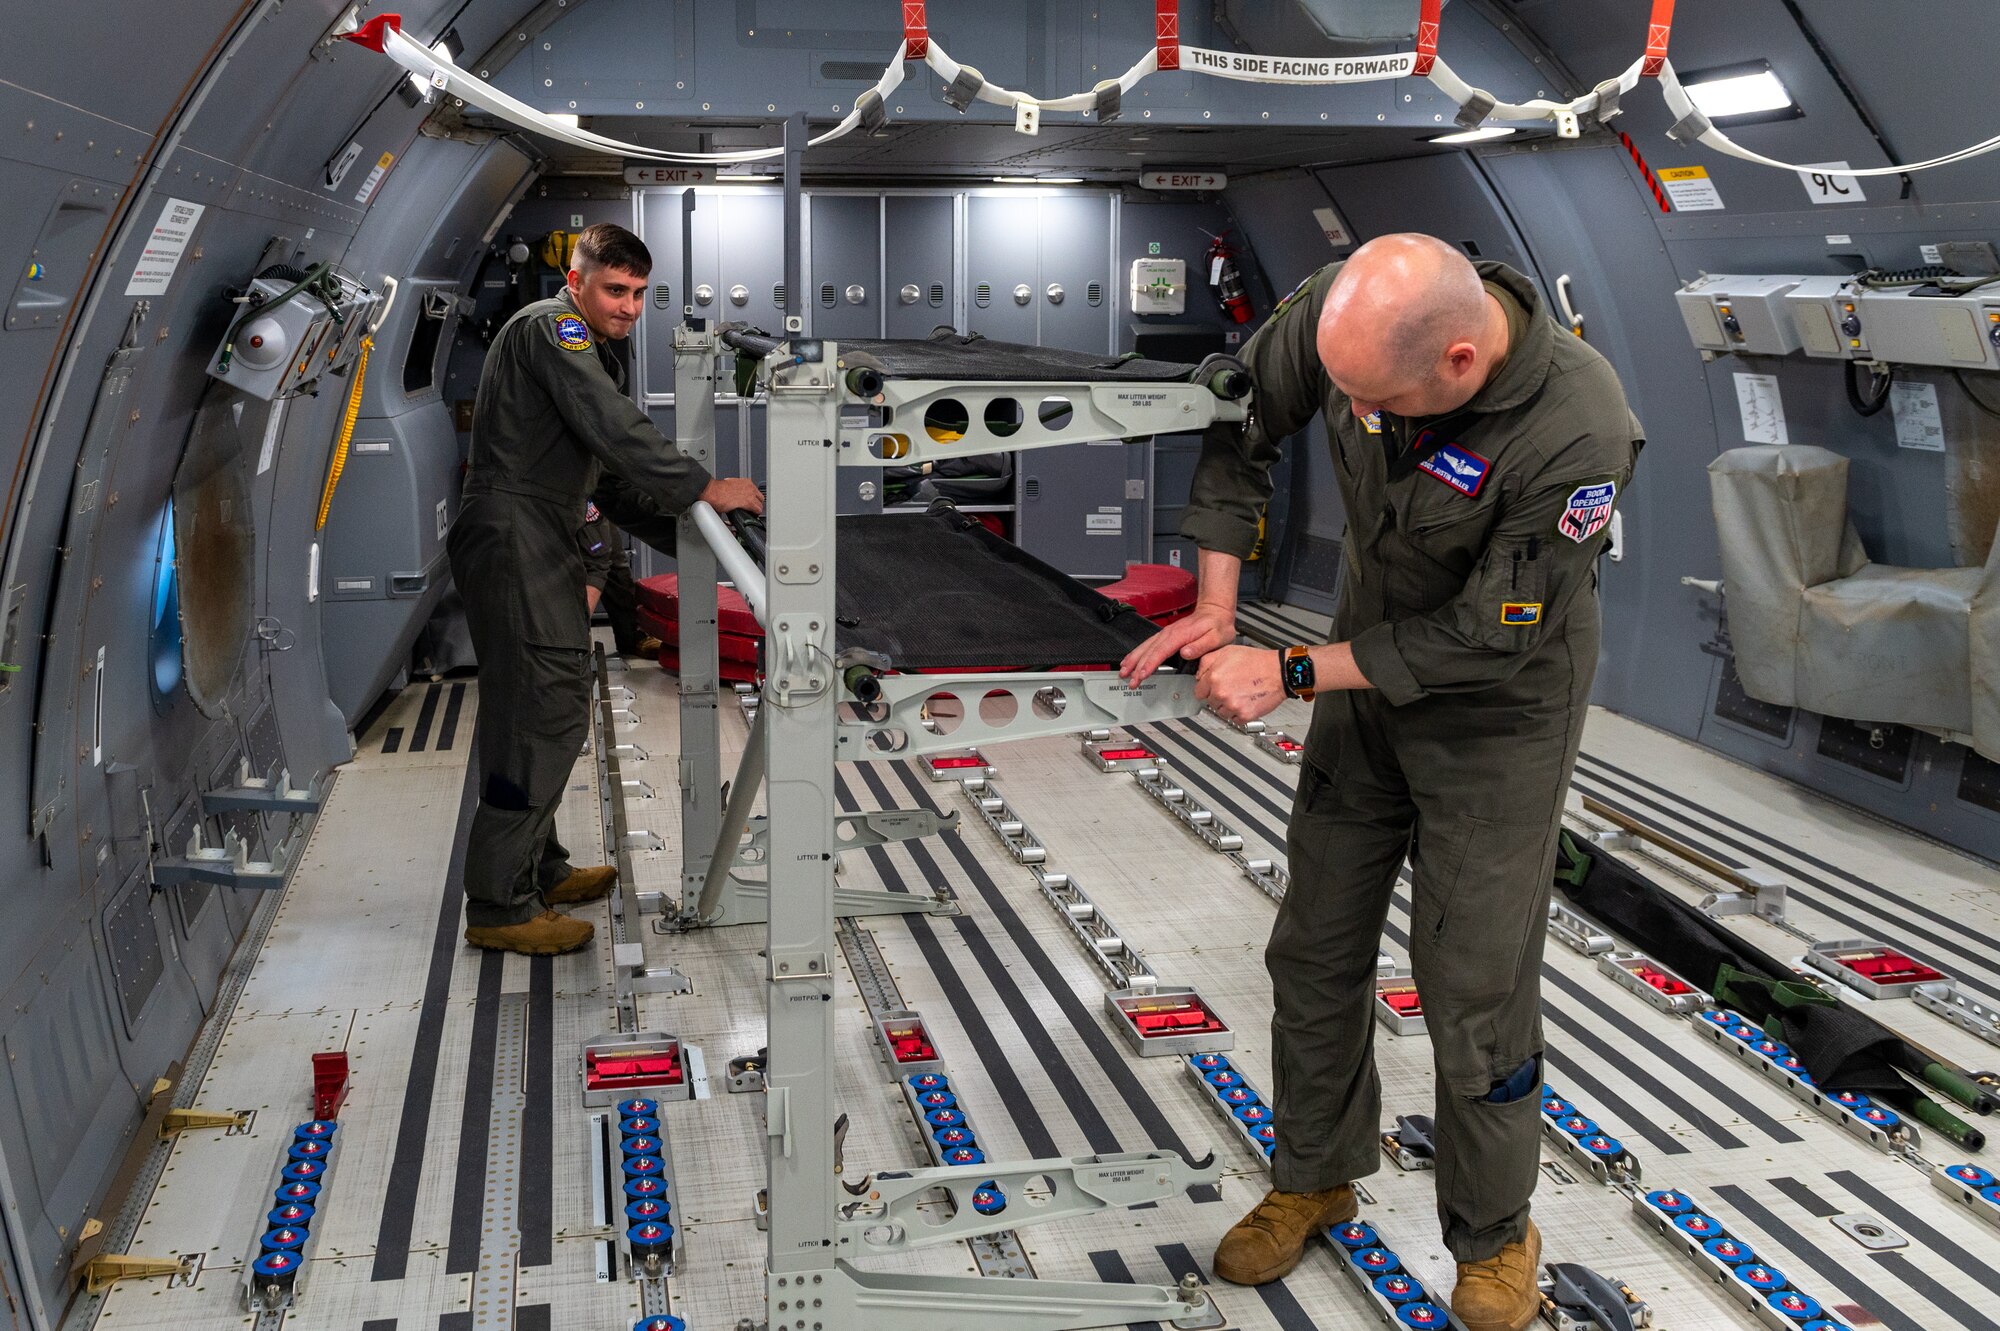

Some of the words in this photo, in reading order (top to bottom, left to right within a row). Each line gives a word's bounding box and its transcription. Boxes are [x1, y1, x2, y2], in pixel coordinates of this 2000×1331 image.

[1192, 51, 1228, 69] THIS
[1233, 58, 1268, 74] SIDE
[1273, 61, 1330, 76] FACING
[1334, 57, 1409, 76] FORWARD
[655, 170, 688, 182] EXIT
[1171, 175, 1201, 187] EXIT
[1812, 173, 1849, 195] 9C
[1434, 468, 1451, 481] JUSTIN
[1452, 477, 1469, 491] MILLER
[1586, 488, 1607, 498] BOOM
[1573, 495, 1611, 507] OPERATOR
